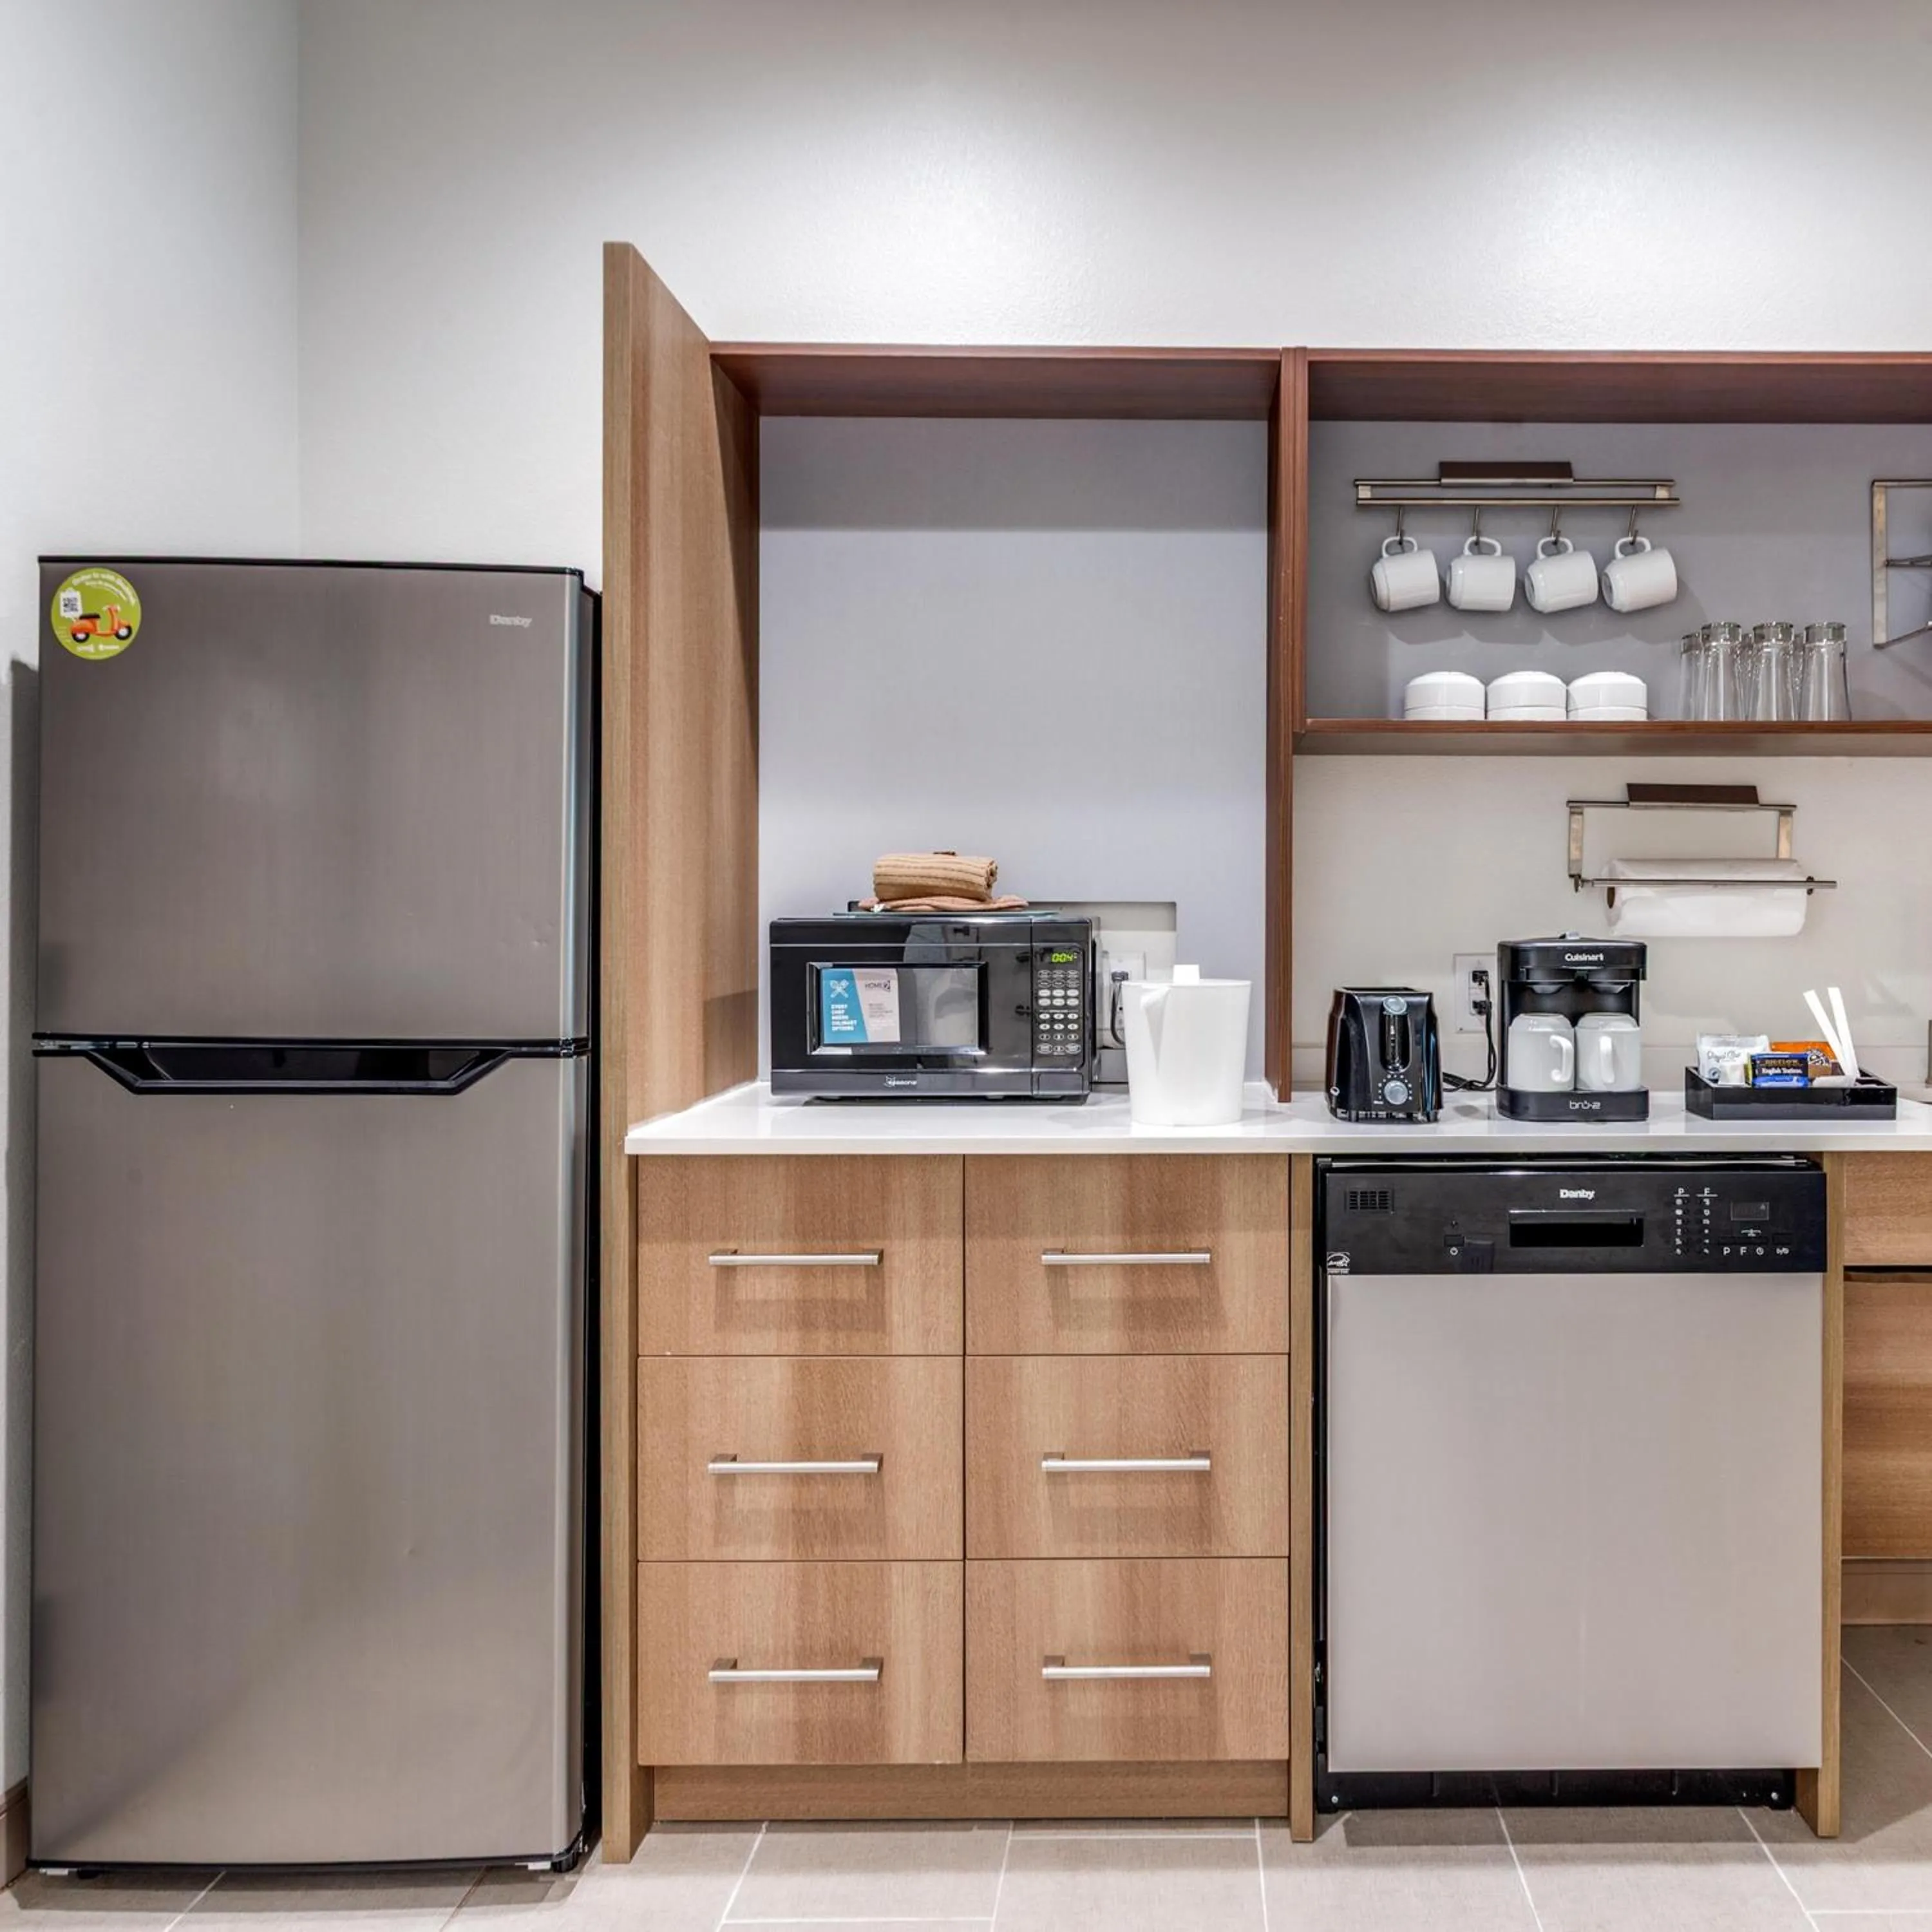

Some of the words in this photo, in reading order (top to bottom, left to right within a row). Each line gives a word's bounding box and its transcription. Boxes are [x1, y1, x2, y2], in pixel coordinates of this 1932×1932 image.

[1565, 952, 1604, 961] Cuisinart
[1560, 1189, 1595, 1200] Danby
[1723, 1247, 1730, 1255] P
[1740, 1247, 1747, 1255] F
